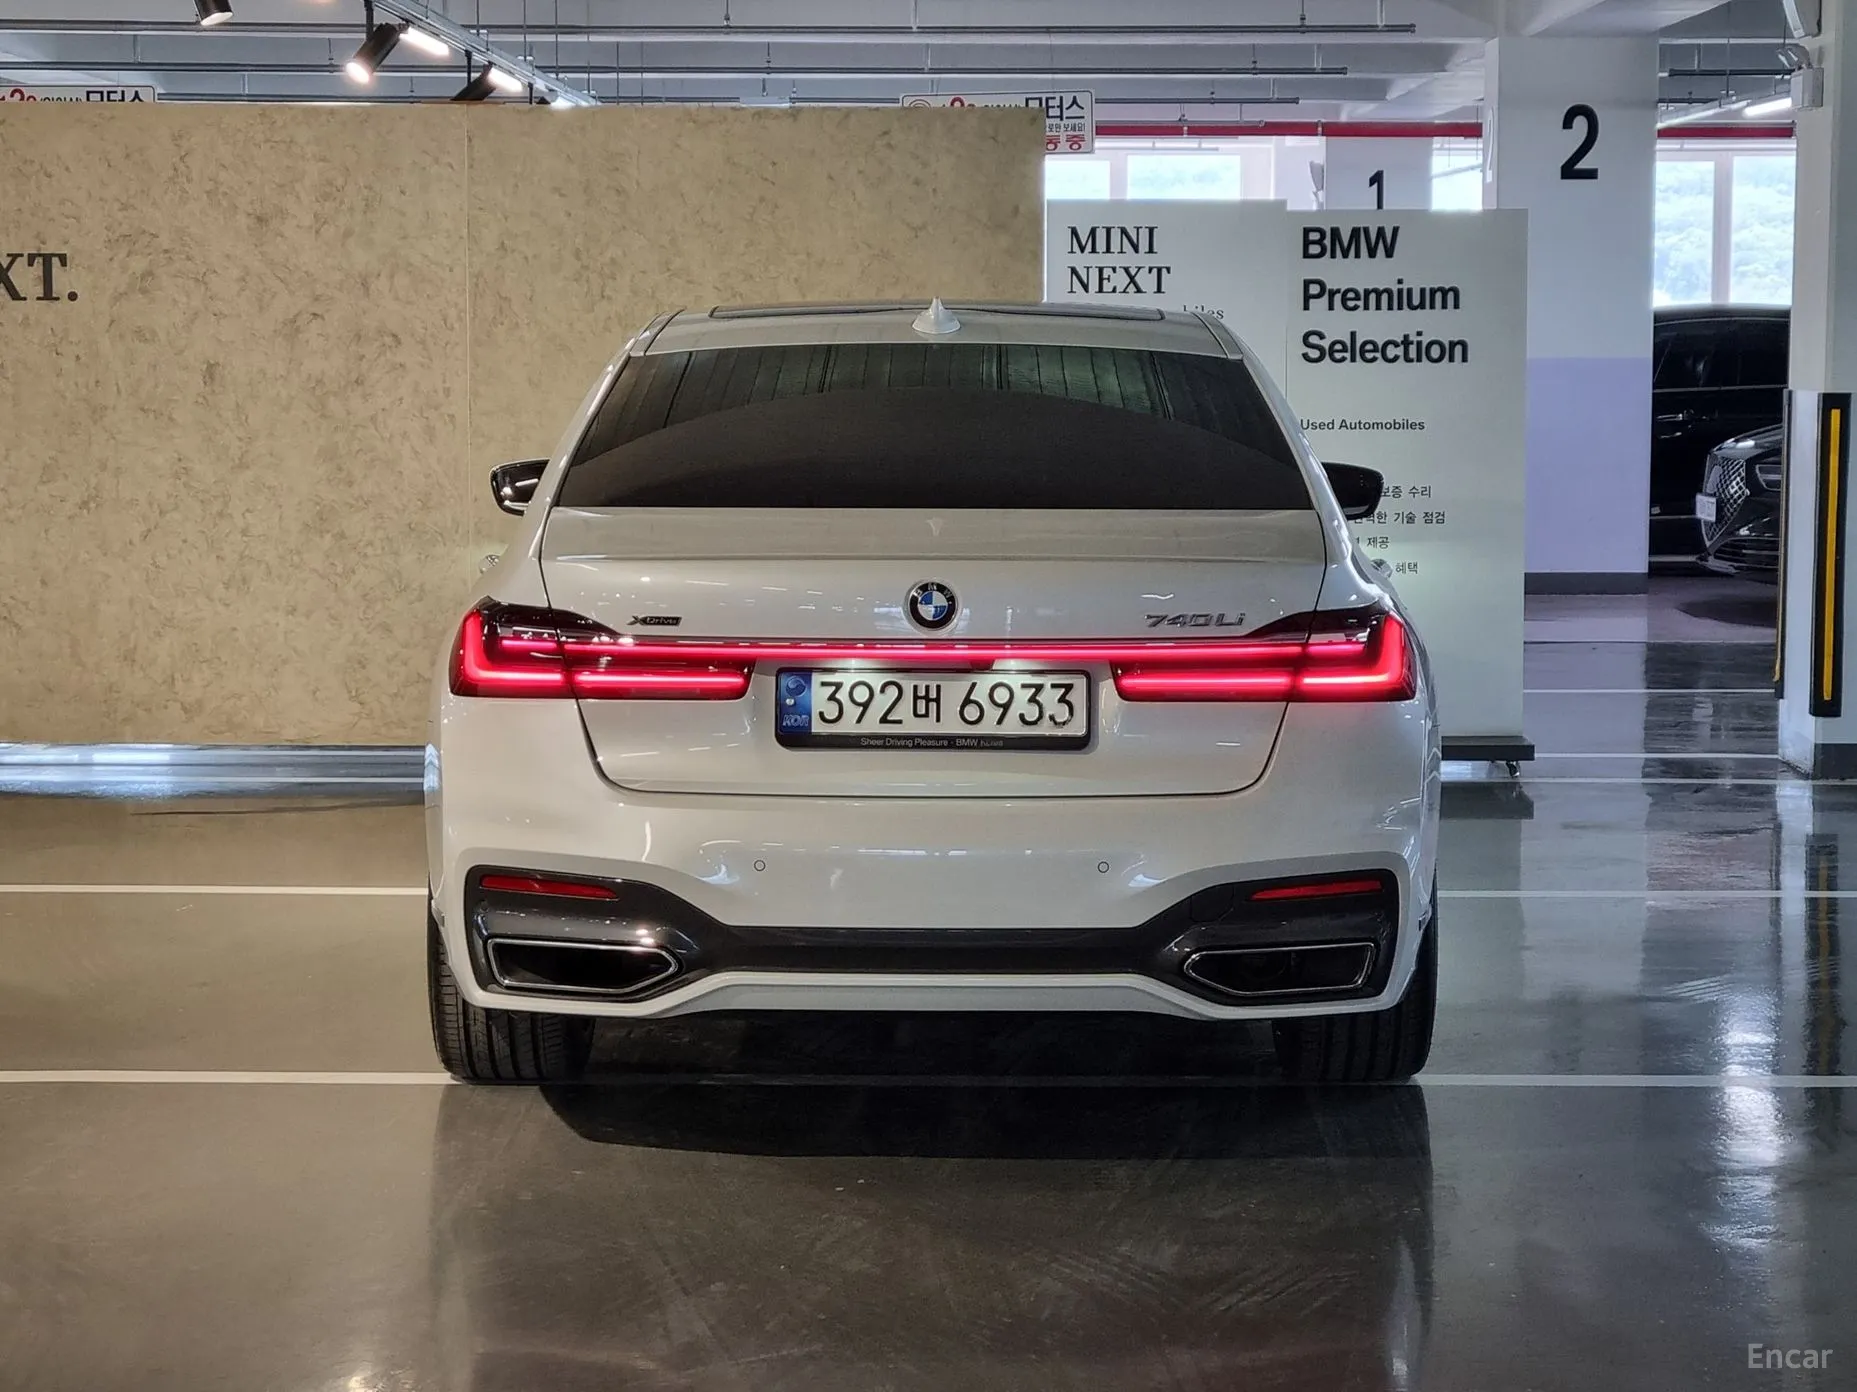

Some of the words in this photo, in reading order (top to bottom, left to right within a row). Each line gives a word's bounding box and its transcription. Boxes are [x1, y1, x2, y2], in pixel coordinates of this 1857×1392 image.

[1065, 134, 1086, 151] 중
[1560, 103, 1599, 180] 2
[1369, 169, 1384, 210] 1
[1067, 226, 1158, 254] MINI
[1302, 226, 1400, 259] BMW
[1067, 266, 1171, 294] NEXT
[1302, 278, 1460, 311] Premium
[1301, 330, 1469, 364] Selection
[1300, 419, 1335, 430] Used
[1338, 419, 1425, 430] Automobiles
[1408, 486, 1431, 498] 수리
[1394, 511, 1417, 524] 기술
[1423, 511, 1445, 524] 점검
[1367, 536, 1390, 549] 제공
[1395, 562, 1418, 574] 혜택
[1144, 612, 1246, 627] 740Li
[818, 680, 942, 725] 392버
[958, 681, 1074, 726] 6933
[782, 714, 809, 727] KOR
[885, 738, 913, 747] Driving
[914, 738, 948, 747] Pleasure
[956, 738, 978, 747] BMW
